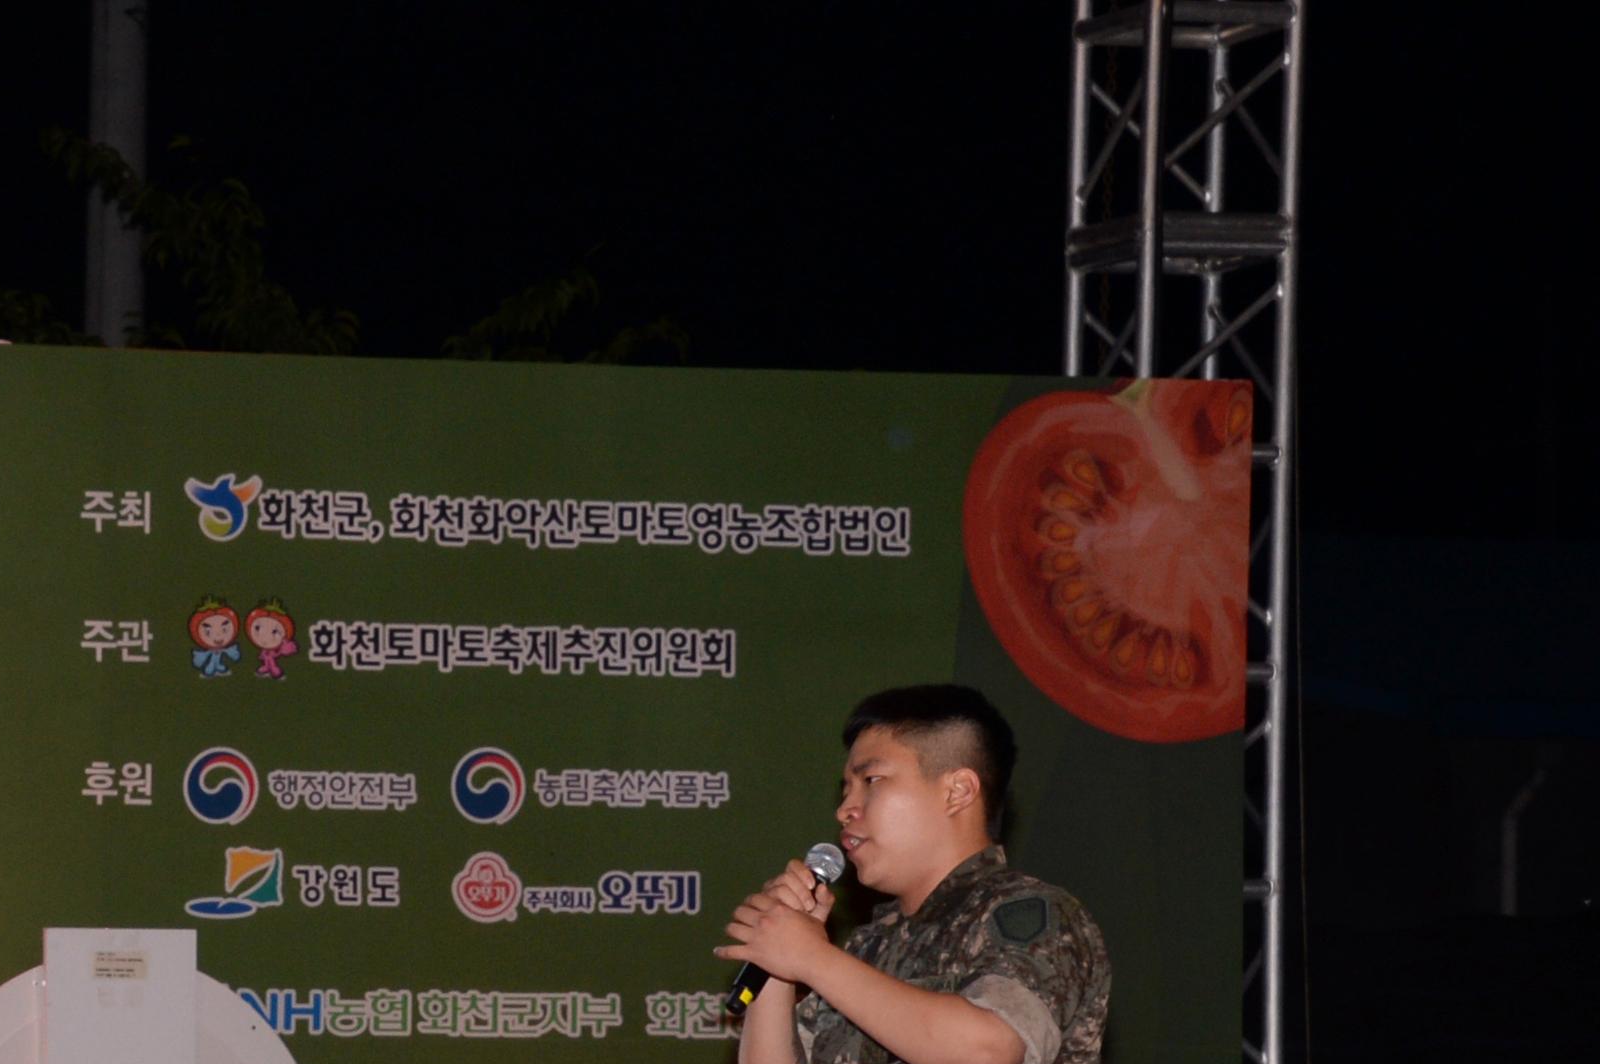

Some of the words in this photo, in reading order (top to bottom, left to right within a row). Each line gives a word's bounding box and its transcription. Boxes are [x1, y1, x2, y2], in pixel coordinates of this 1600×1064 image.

[80, 490, 151, 534] 주최
[259, 490, 382, 541] 화천군,
[390, 493, 910, 556] 화천화악산토마토영농조합법인
[80, 620, 153, 662] 주관
[310, 620, 736, 677] 화천토마토축제추진위원회
[82, 761, 152, 806] 후원
[268, 770, 417, 811] 행정안전부
[533, 768, 730, 808] 농림축산식품부
[293, 865, 400, 907] 강원도
[522, 887, 595, 912] 주식회사
[598, 871, 701, 915] 오뚜기
[417, 991, 622, 1037] 화천군지부
[645, 991, 741, 1039] 화천
